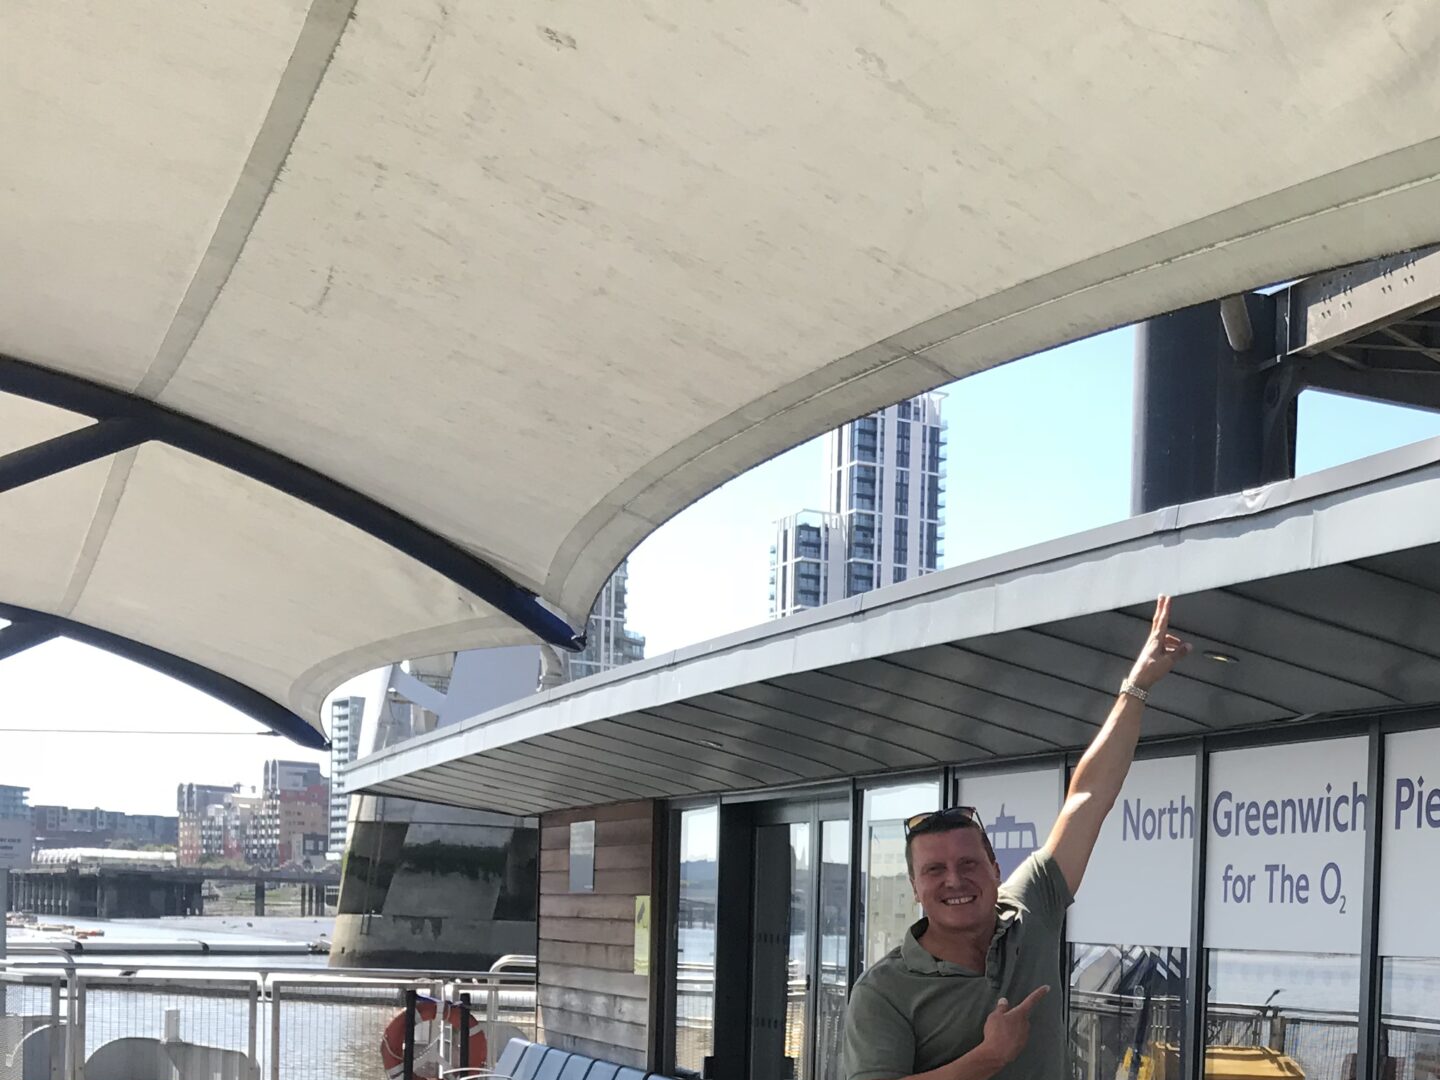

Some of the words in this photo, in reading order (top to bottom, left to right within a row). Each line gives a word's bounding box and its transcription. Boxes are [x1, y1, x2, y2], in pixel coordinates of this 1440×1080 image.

[1123, 796, 1195, 841] North
[1212, 780, 1369, 838] Greenwich
[1222, 864, 1257, 904] for
[1264, 864, 1310, 905] The
